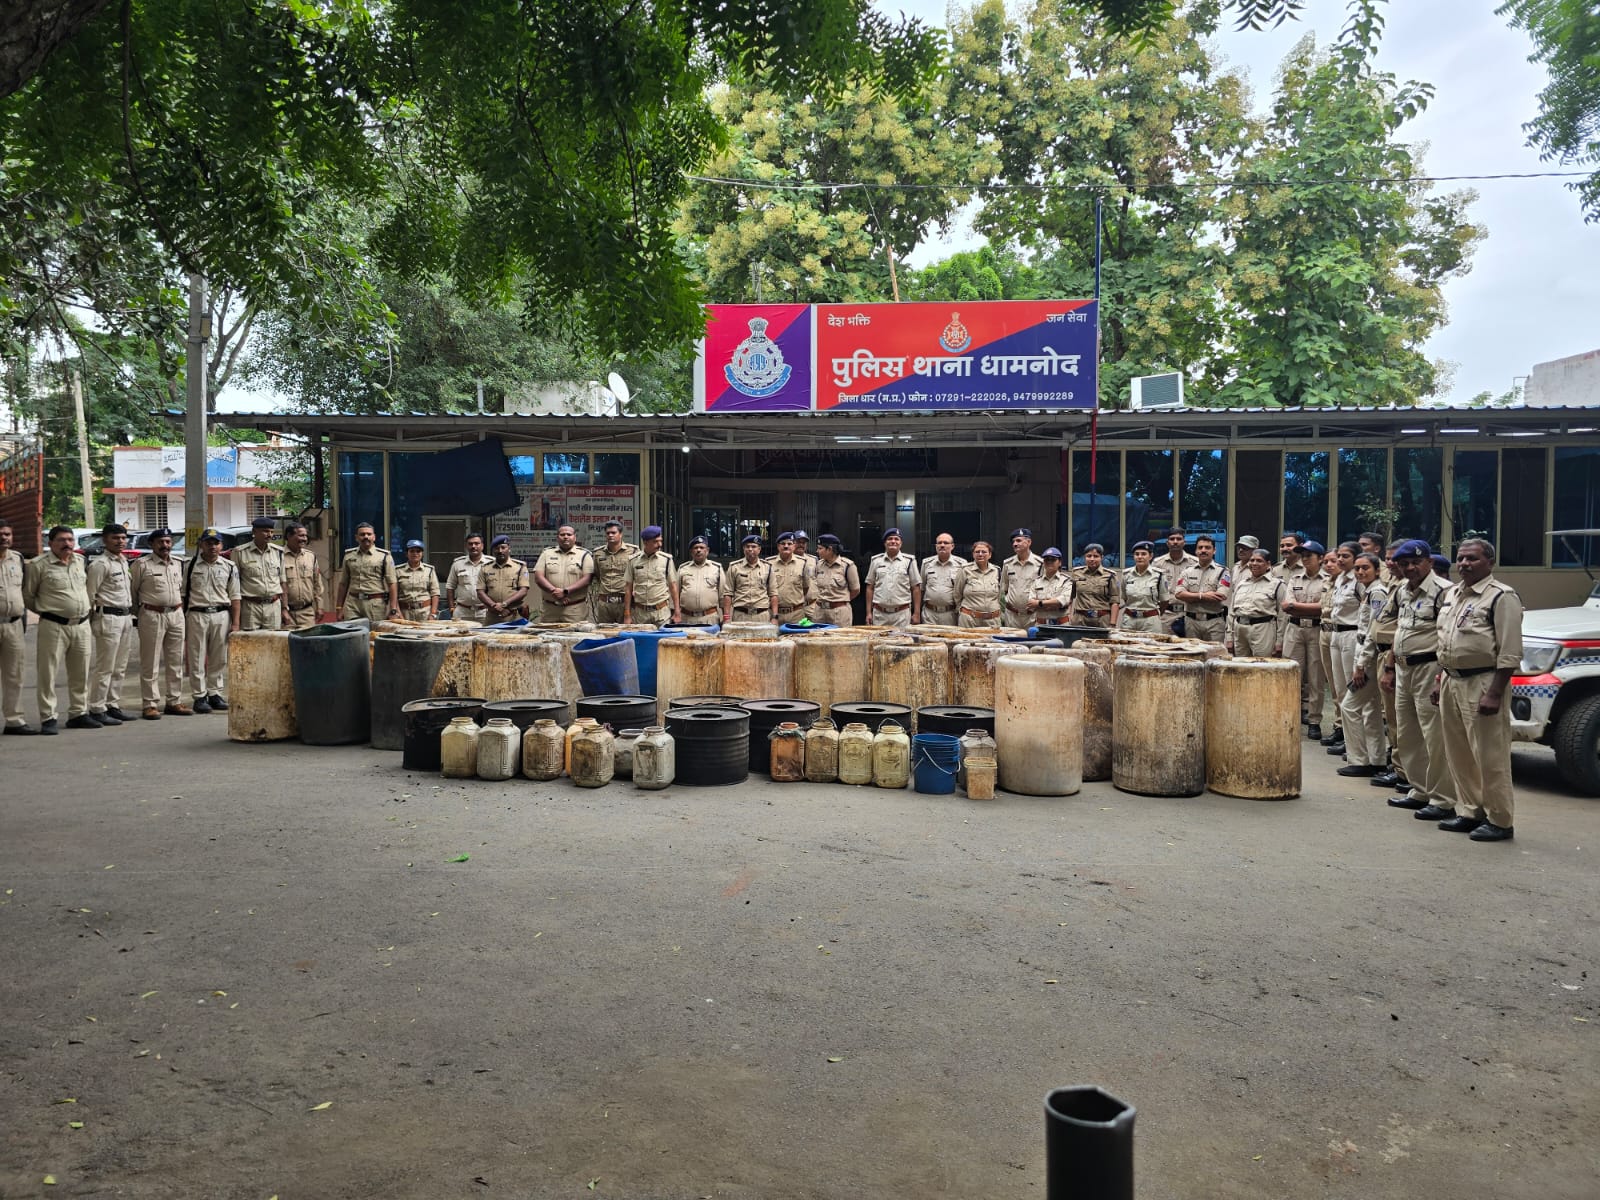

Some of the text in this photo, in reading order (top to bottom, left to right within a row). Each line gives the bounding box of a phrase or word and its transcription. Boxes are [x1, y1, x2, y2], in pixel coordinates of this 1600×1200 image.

[828, 313, 871, 327] देश भक्ति
[1046, 310, 1087, 323] जन सेवा
[831, 345, 1081, 388] पुलिस थाना धामनोद
[838, 392, 859, 403] जिला
[860, 394, 876, 402] धार
[908, 391, 928, 402] फोन
[1013, 391, 1074, 401] 9479992289
